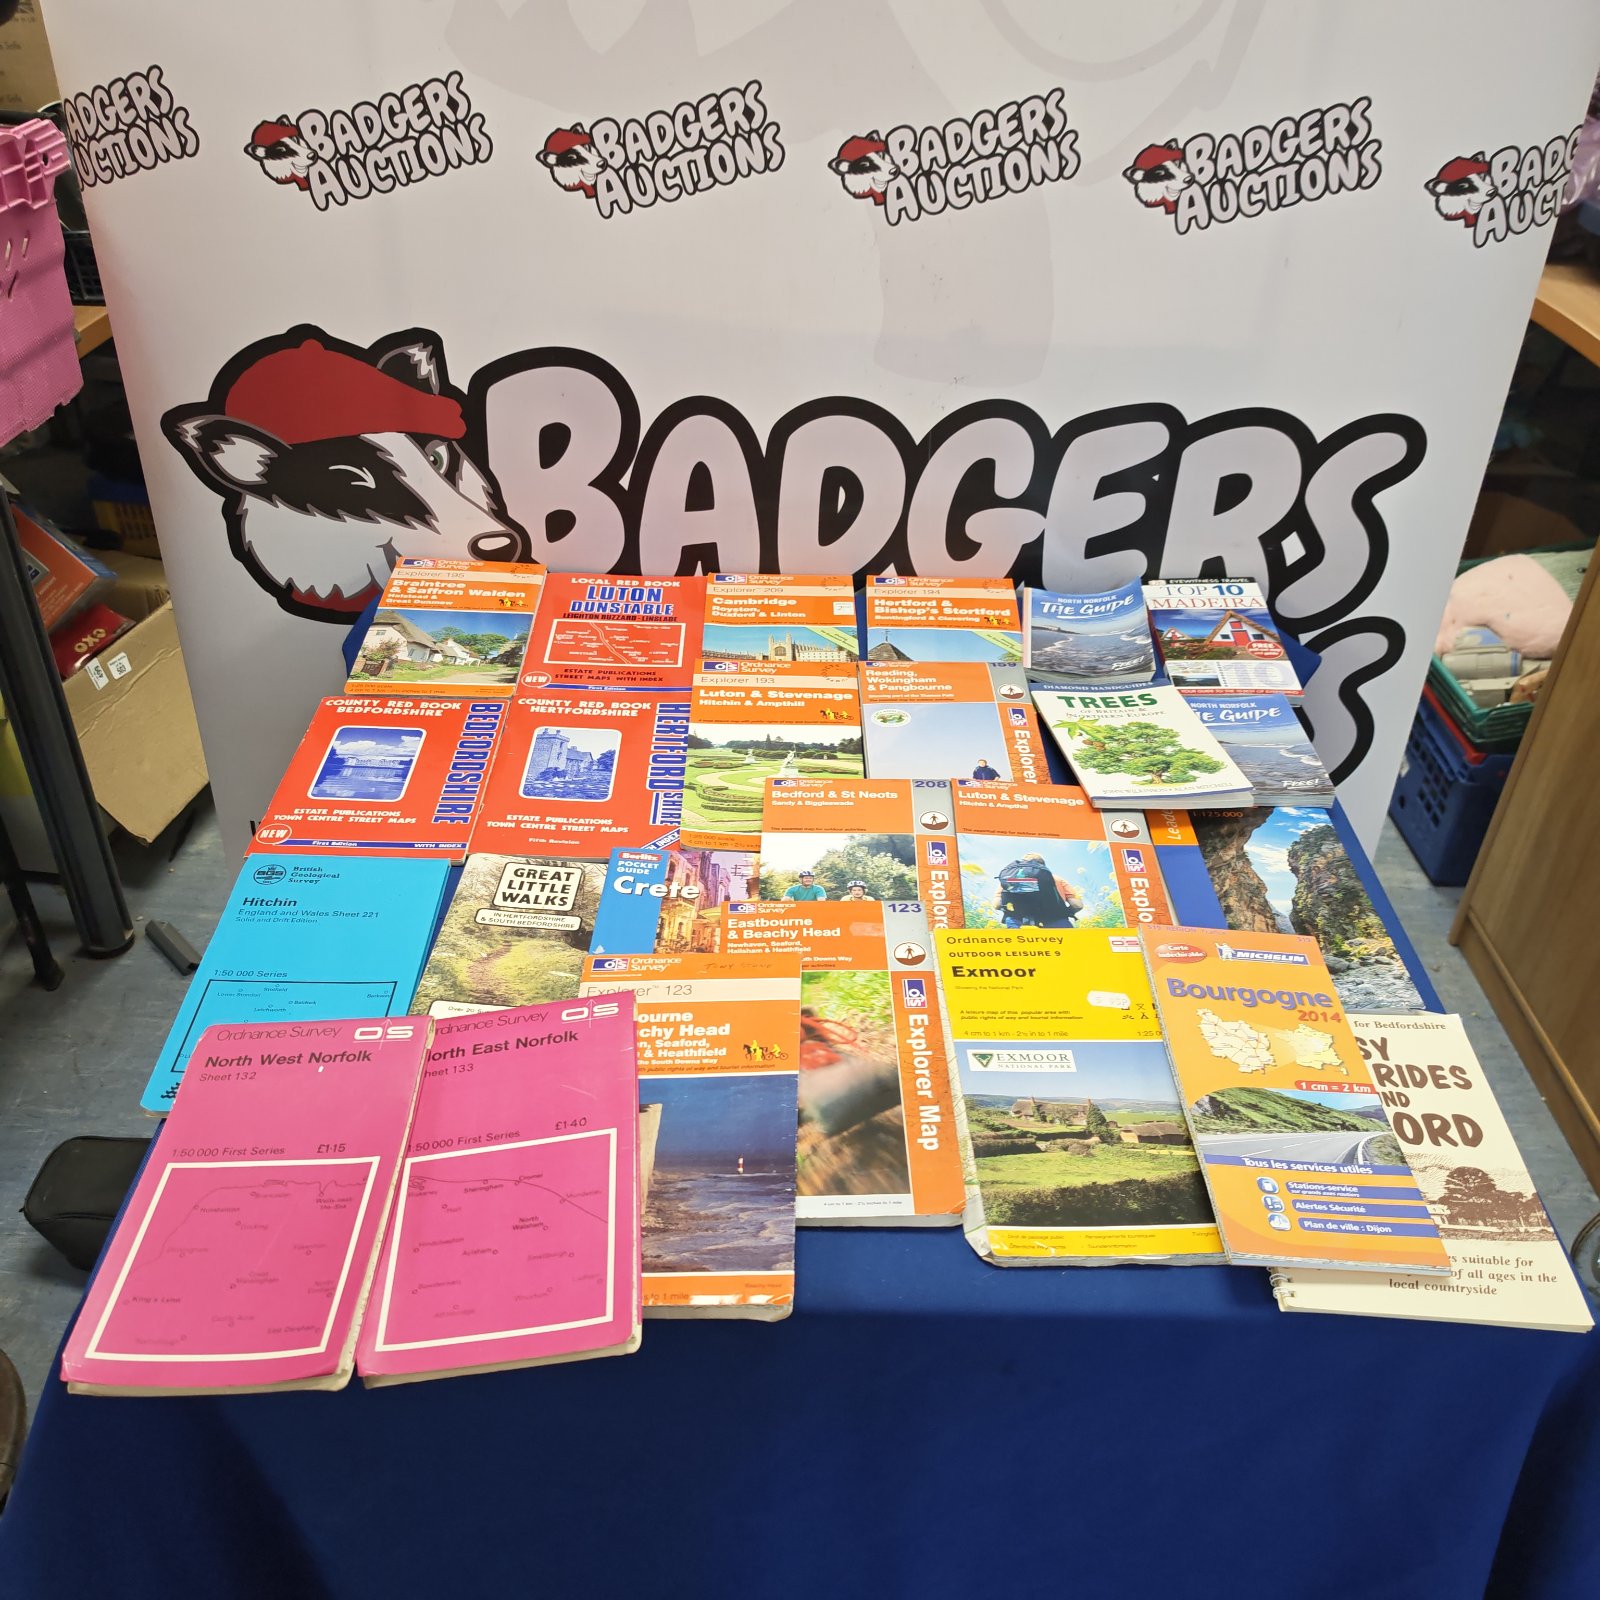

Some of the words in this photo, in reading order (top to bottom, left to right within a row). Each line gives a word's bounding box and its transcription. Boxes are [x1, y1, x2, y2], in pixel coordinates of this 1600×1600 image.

[64, 64, 174, 143] ADGERS
[299, 70, 472, 161] BADGERS
[591, 80, 767, 169] BADGERS
[884, 87, 1066, 179] BADGERS
[1182, 96, 1373, 183] BADGERS
[72, 106, 200, 191] UCTIONS
[309, 112, 493, 211] AUCTIONS
[598, 122, 786, 219] AUCTIONS
[884, 130, 1081, 226] AUCTIONS
[1173, 139, 1382, 235] AUCTIONS
[470, 346, 1427, 622] BADGERS
[392, 579, 466, 588] Braintree
[571, 577, 610, 585] LOCAL
[616, 578, 640, 586] RED
[407, 586, 464, 595] Saffron
[468, 588, 526, 598] Walden
[586, 585, 664, 602] LUTON
[1159, 585, 1208, 596] TOP
[1212, 584, 1244, 596] 10
[712, 597, 797, 606] Cambridge
[874, 599, 937, 607] Hertford
[1057, 597, 1082, 605] NORTH
[1083, 595, 1117, 604] NORFOLK
[1152, 597, 1265, 608] MADEIRA
[570, 600, 674, 615] DUNSTABLE
[943, 607, 1011, 617] Stortford
[1040, 602, 1075, 615] THE
[865, 669, 917, 678] Reading,
[700, 676, 750, 684] Explorer
[867, 676, 937, 685] Wokingham
[1043, 683, 1080, 691] DIAMOND
[1083, 681, 1153, 690] HANDGUIDES
[879, 684, 953, 692] Pangbourne
[699, 689, 746, 699] Luton
[767, 690, 853, 702] Stevenage
[1057, 692, 1159, 709] TREES
[325, 699, 380, 707] COUNTY
[387, 701, 414, 709] RED
[420, 702, 462, 710] BOOK
[517, 698, 572, 707] COUNTY
[579, 700, 606, 709] RED
[612, 701, 652, 710] BOOK
[699, 699, 743, 707] Hitchin
[755, 699, 805, 708] Ampthill
[336, 706, 444, 717] BEDFORDSHIRE
[530, 705, 638, 717] HERTFORDSHIRE
[432, 702, 504, 825] BEDFORDSHIRE
[914, 780, 948, 788] 208
[771, 790, 827, 799] Bedford
[858, 790, 898, 799] Neots
[958, 790, 997, 801] Luton
[1012, 792, 1085, 807] Stevenage
[996, 802, 1029, 810] Ampthill
[294, 808, 328, 816] ESTATE
[333, 809, 401, 817] PUBLICATIONS
[307, 815, 344, 823] CENTRE
[506, 814, 540, 822] ESTATE
[545, 816, 613, 825] PUBLICATIONS
[486, 821, 516, 829] TOWN
[520, 822, 557, 831] CENTRE
[561, 824, 595, 832] STREET
[259, 829, 288, 838] NEW
[616, 866, 650, 875] GUIDE
[618, 860, 659, 870] POCKET
[513, 868, 575, 881] GREAT
[288, 877, 320, 885] Survey
[506, 879, 572, 894] LITTLE
[613, 875, 701, 900] Crete
[242, 897, 298, 907] Hitchin
[501, 892, 569, 907] WALKS
[238, 909, 278, 917] England
[887, 902, 922, 913] 123
[503, 913, 566, 922] HERTFORDSHIRE
[727, 917, 813, 929] Eastbourne
[743, 929, 802, 941] Beachy
[803, 927, 841, 938] Head
[946, 935, 1012, 945] Ordnance
[1016, 935, 1064, 946] Survey
[631, 957, 682, 965] Ordnance
[1236, 950, 1305, 963] MICHELIN
[214, 969, 234, 977] 1:50
[951, 965, 1036, 978] Exmoor
[1166, 978, 1334, 1010] Bourgogne
[497, 1010, 550, 1028] Survey
[1297, 1010, 1342, 1024] 2014
[679, 1023, 731, 1037] Head
[1354, 1020, 1370, 1028] for
[1373, 1021, 1446, 1030] Bedfordshire
[216, 1028, 287, 1041] Ordnance
[290, 1025, 343, 1039] Survey
[472, 1040, 510, 1056] East
[515, 1030, 579, 1050] Norfolk
[655, 1038, 710, 1049] Seaford,
[205, 1054, 253, 1068] North
[260, 1053, 303, 1066] West
[308, 1050, 372, 1064] Norfolk
[657, 1048, 727, 1058] Heathfield
[908, 1013, 933, 1099] Explorer
[996, 1053, 1071, 1062] EXMOOR
[200, 1073, 233, 1082] Sheet
[235, 1071, 257, 1081] 132
[1372, 1063, 1473, 1090] RIDES
[916, 1104, 941, 1151] Map
[457, 1134, 482, 1145] First
[486, 1130, 521, 1143] Series
[172, 1148, 195, 1157] 1:50
[222, 1147, 247, 1156] First
[251, 1146, 285, 1155] Series
[1242, 1157, 1270, 1168] Tous
[1289, 1161, 1337, 1173] services
[1339, 1163, 1373, 1174] utiles
[463, 1183, 504, 1194] Sheringham
[1287, 1181, 1359, 1193] Stations-service
[1295, 1201, 1328, 1211] Alertes
[1328, 1203, 1366, 1213] Sécurité
[1303, 1220, 1324, 1230] Plan
[1339, 1223, 1360, 1232] ville
[1366, 1224, 1392, 1234] Dijon
[1461, 1254, 1513, 1267] suitable
[1514, 1256, 1534, 1268] for
[1450, 1268, 1463, 1279] of
[1466, 1267, 1484, 1279] all
[1488, 1271, 1517, 1283] ages
[1521, 1271, 1535, 1281] in
[1538, 1272, 1558, 1283] the
[1389, 1278, 1420, 1290] local
[1424, 1281, 1498, 1296] countryside
